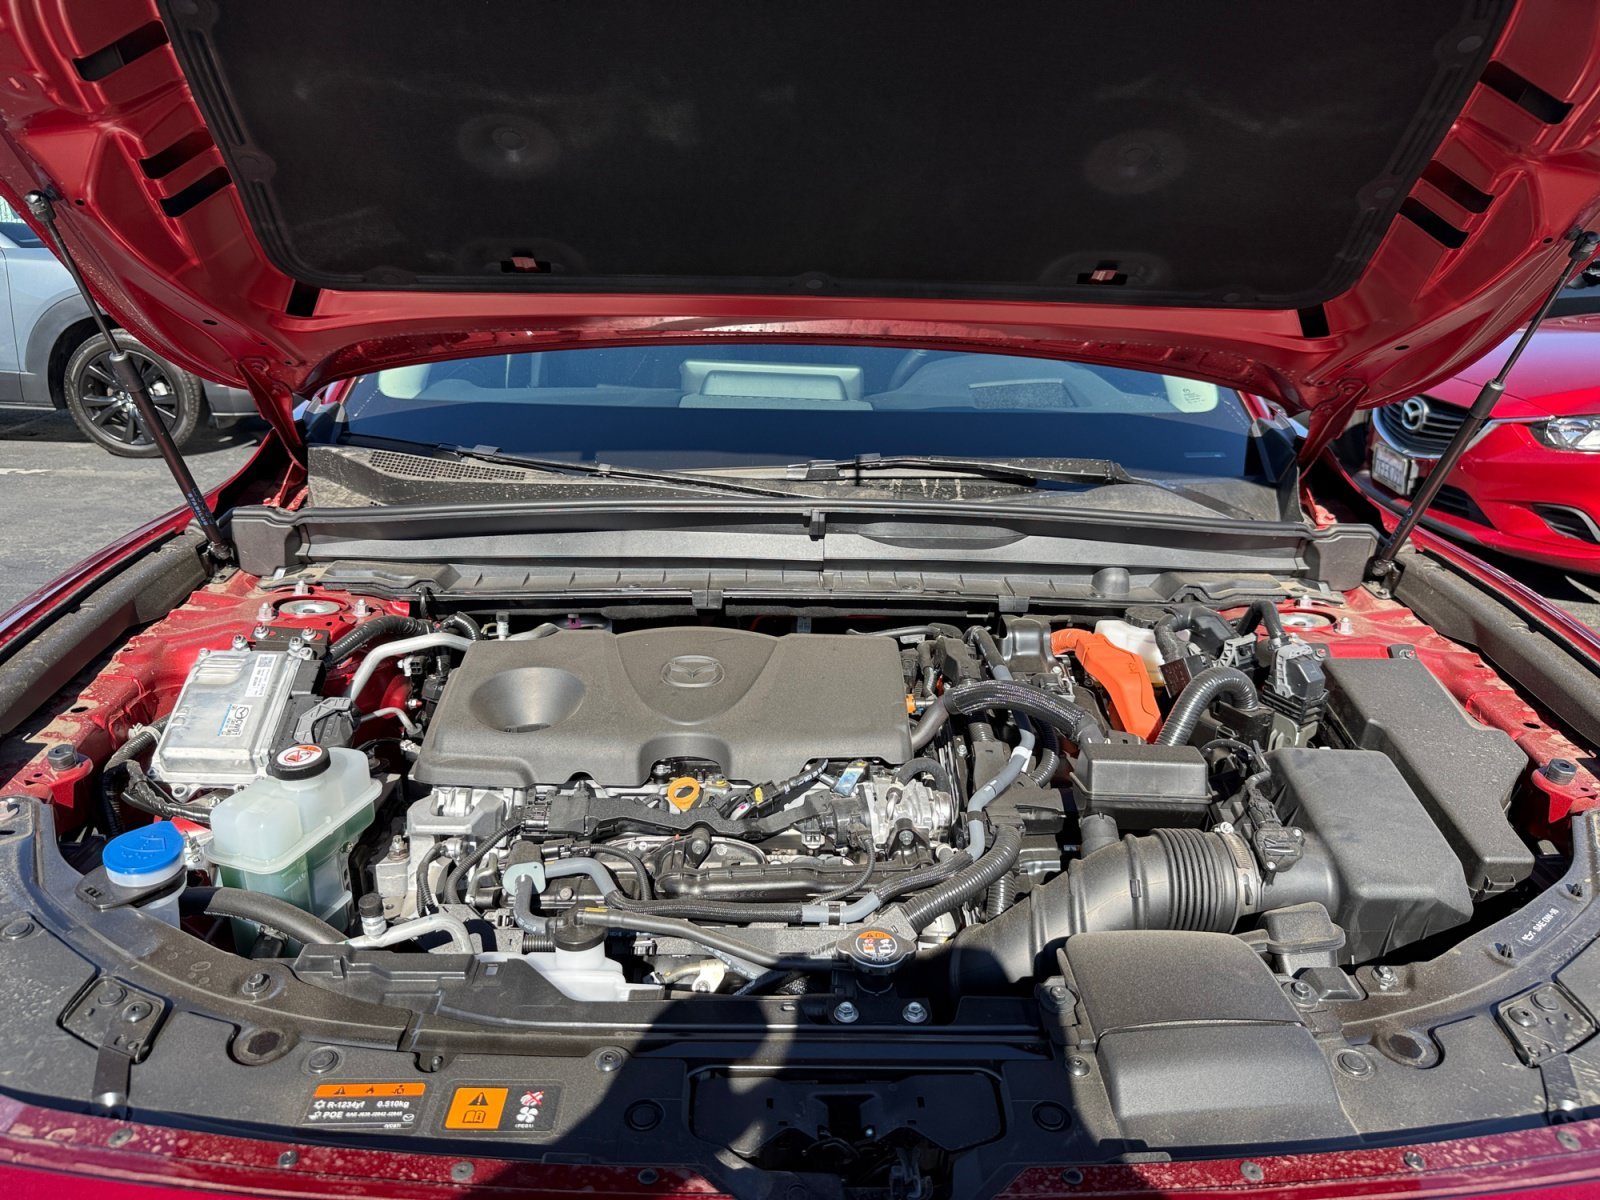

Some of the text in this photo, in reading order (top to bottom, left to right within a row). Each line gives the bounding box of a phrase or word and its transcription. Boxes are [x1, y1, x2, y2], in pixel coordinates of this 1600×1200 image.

[326, 1101, 410, 1109] R-1234yf 0.510kg
[322, 1111, 344, 1119] POE
